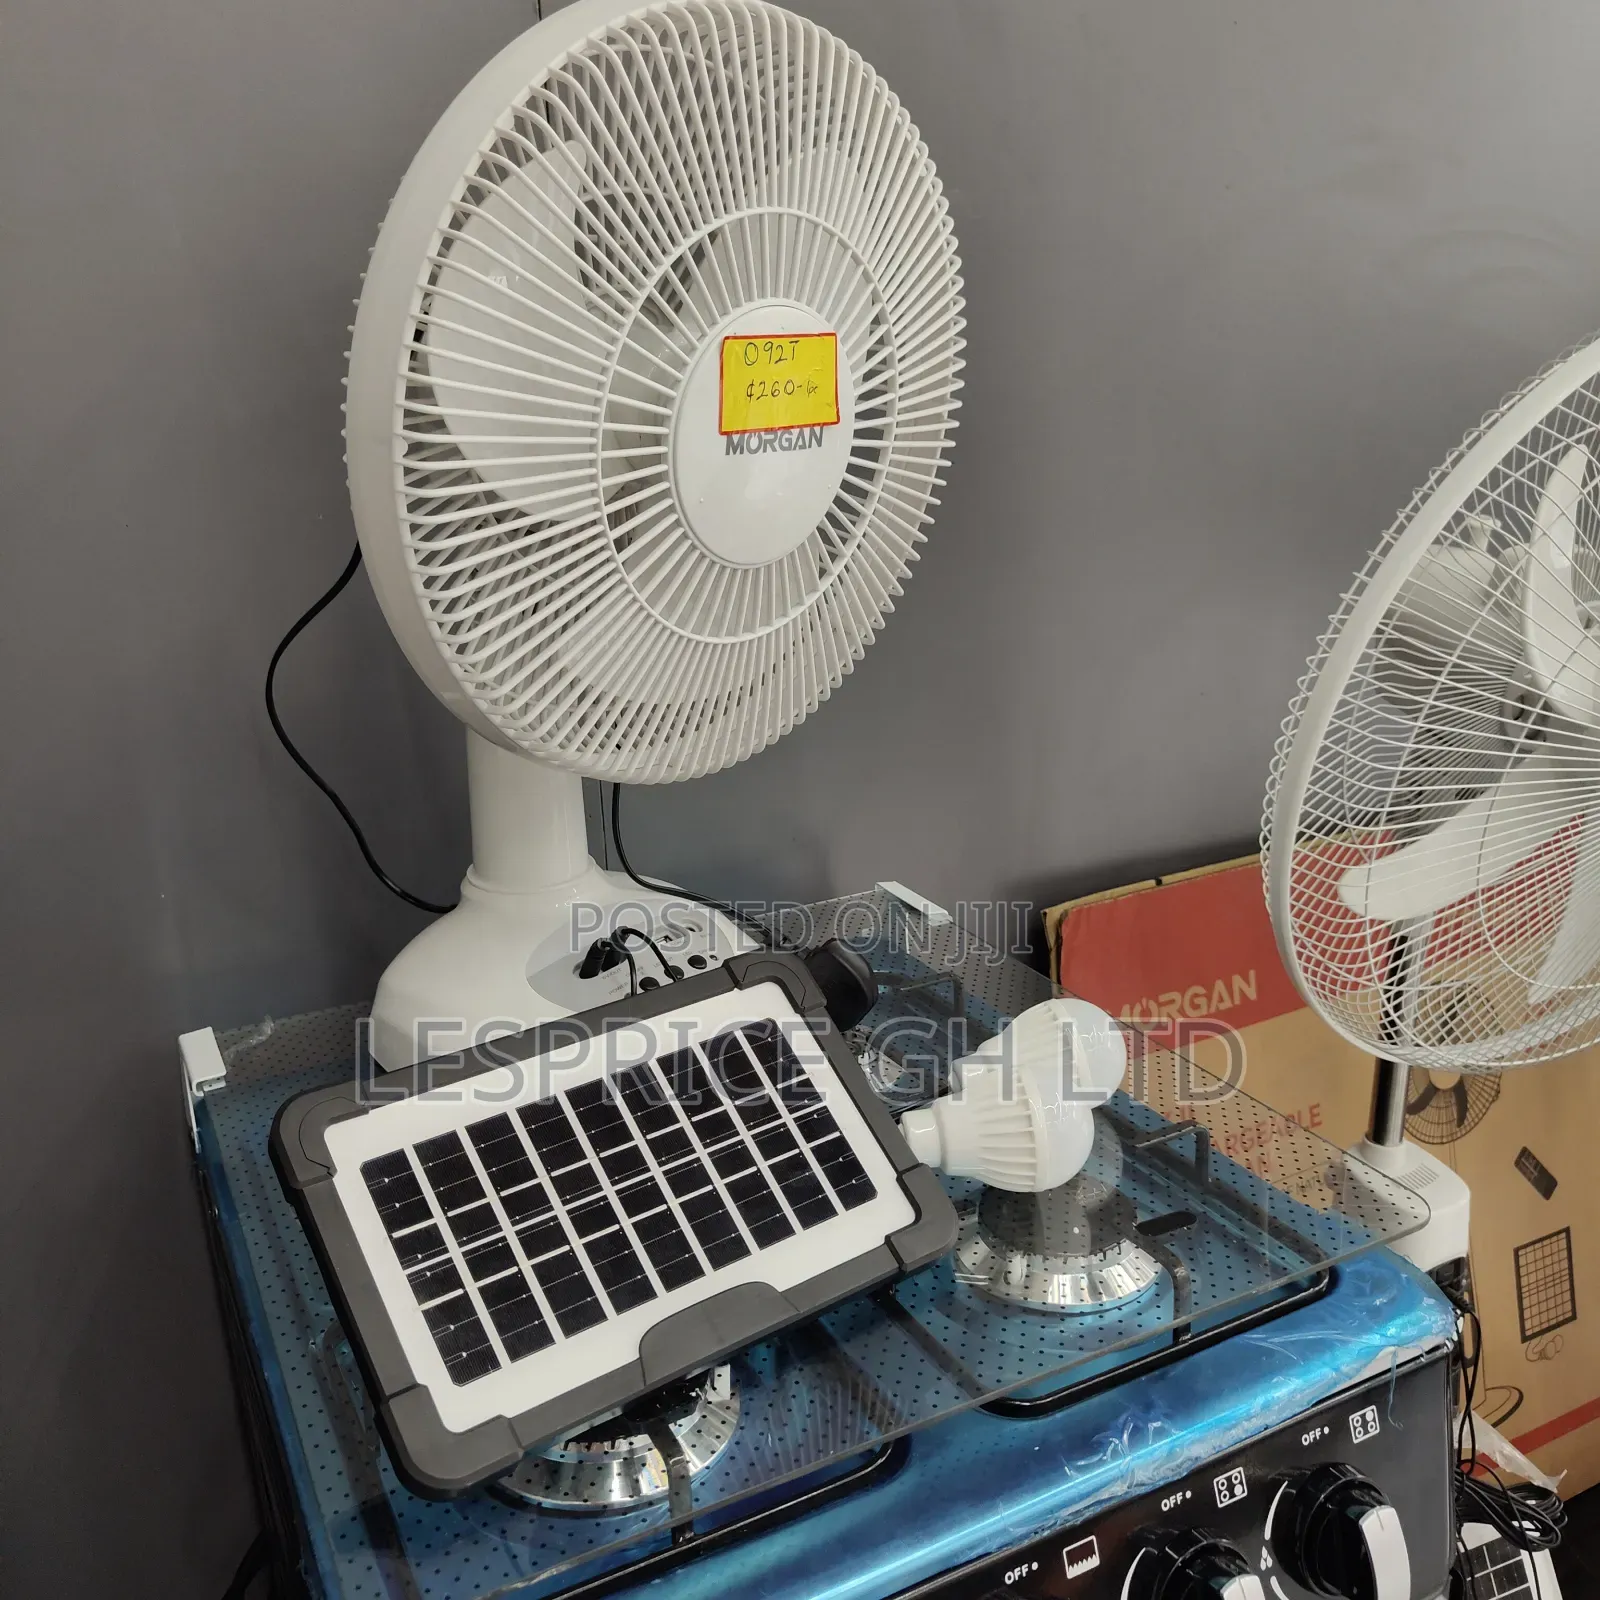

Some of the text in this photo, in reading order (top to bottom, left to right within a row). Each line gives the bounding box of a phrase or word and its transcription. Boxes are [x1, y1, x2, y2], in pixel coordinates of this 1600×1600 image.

[725, 427, 824, 456] MORGAN
[1301, 1427, 1322, 1446] OFF
[1161, 1491, 1183, 1512] OFF
[1004, 1563, 1029, 1585] OFF
